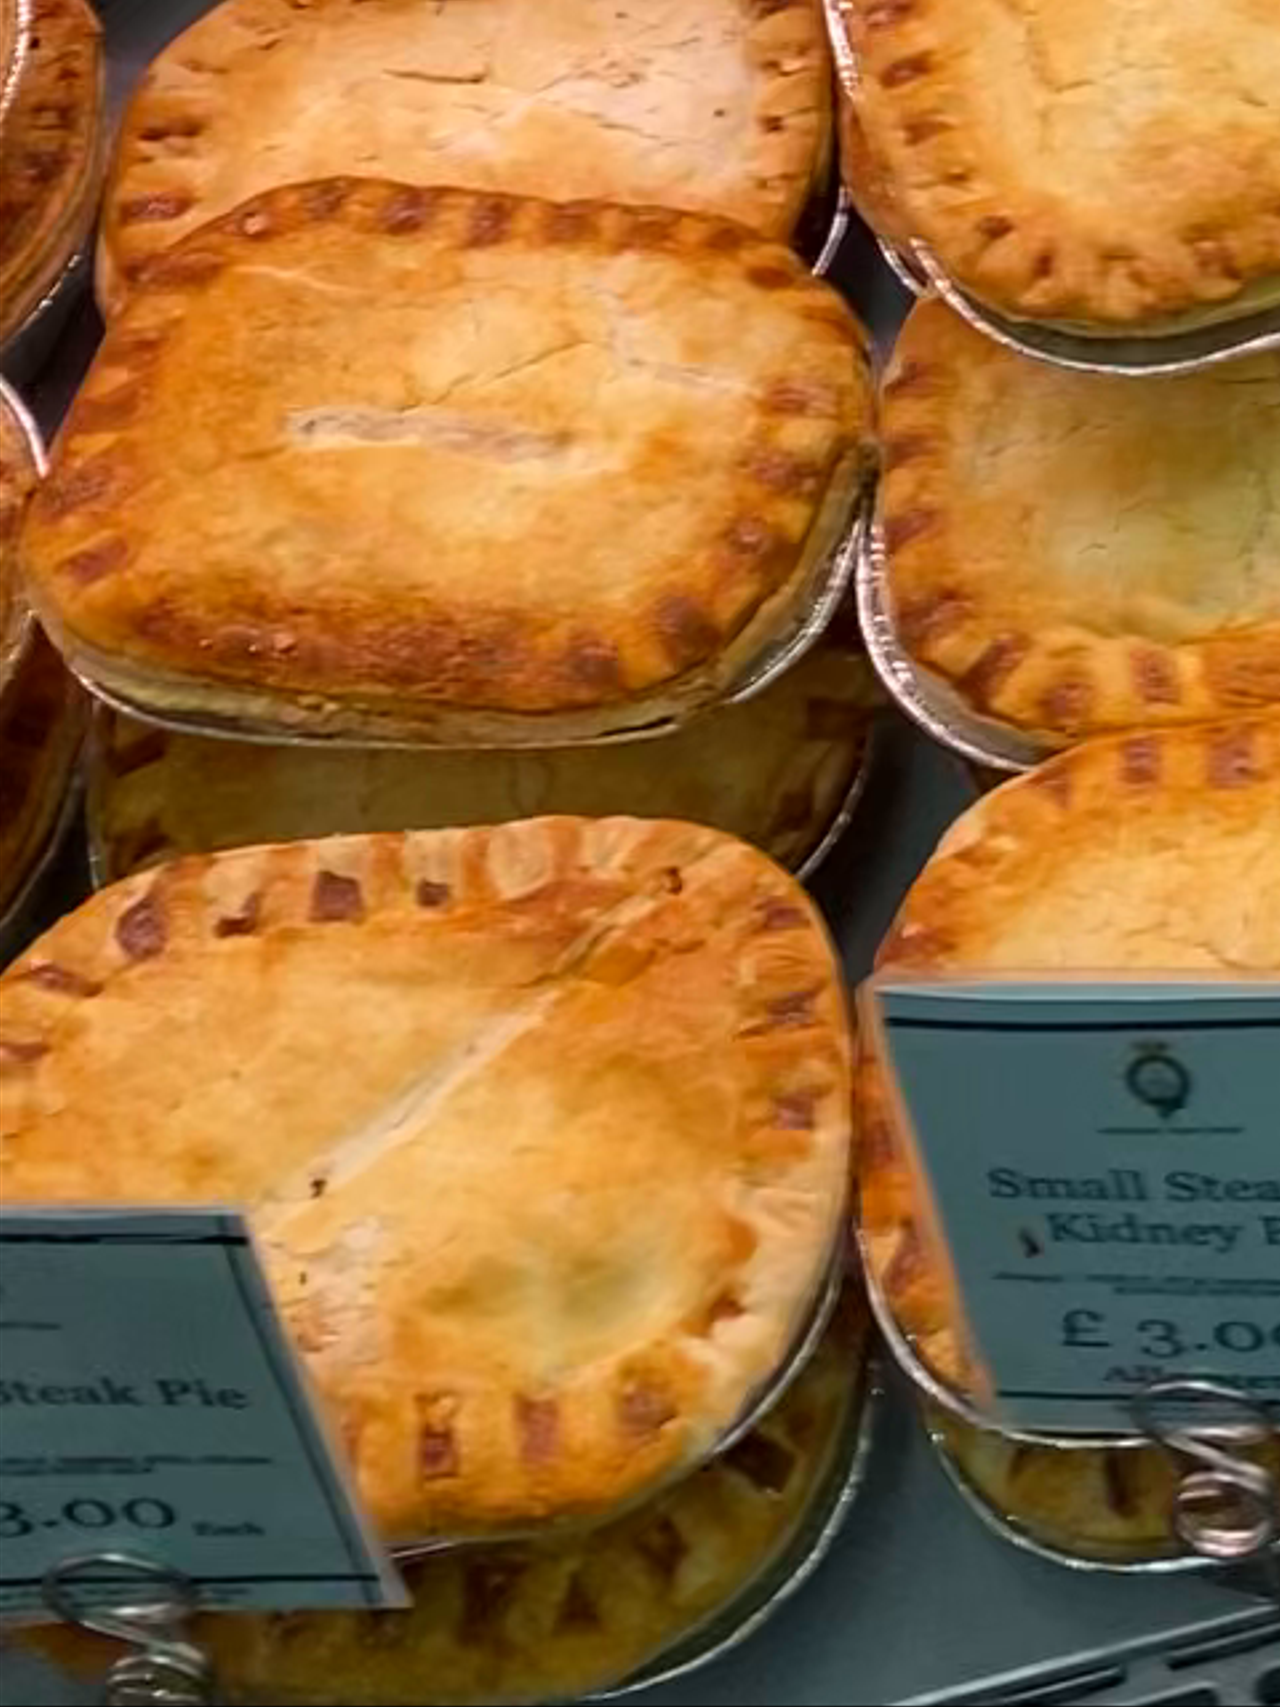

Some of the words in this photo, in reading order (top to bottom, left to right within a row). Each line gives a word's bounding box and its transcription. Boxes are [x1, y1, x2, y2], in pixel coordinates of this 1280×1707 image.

[987, 1167, 1147, 1202] Small
[1046, 1212, 1242, 1254] Kidney
[155, 1378, 250, 1410] Pie
